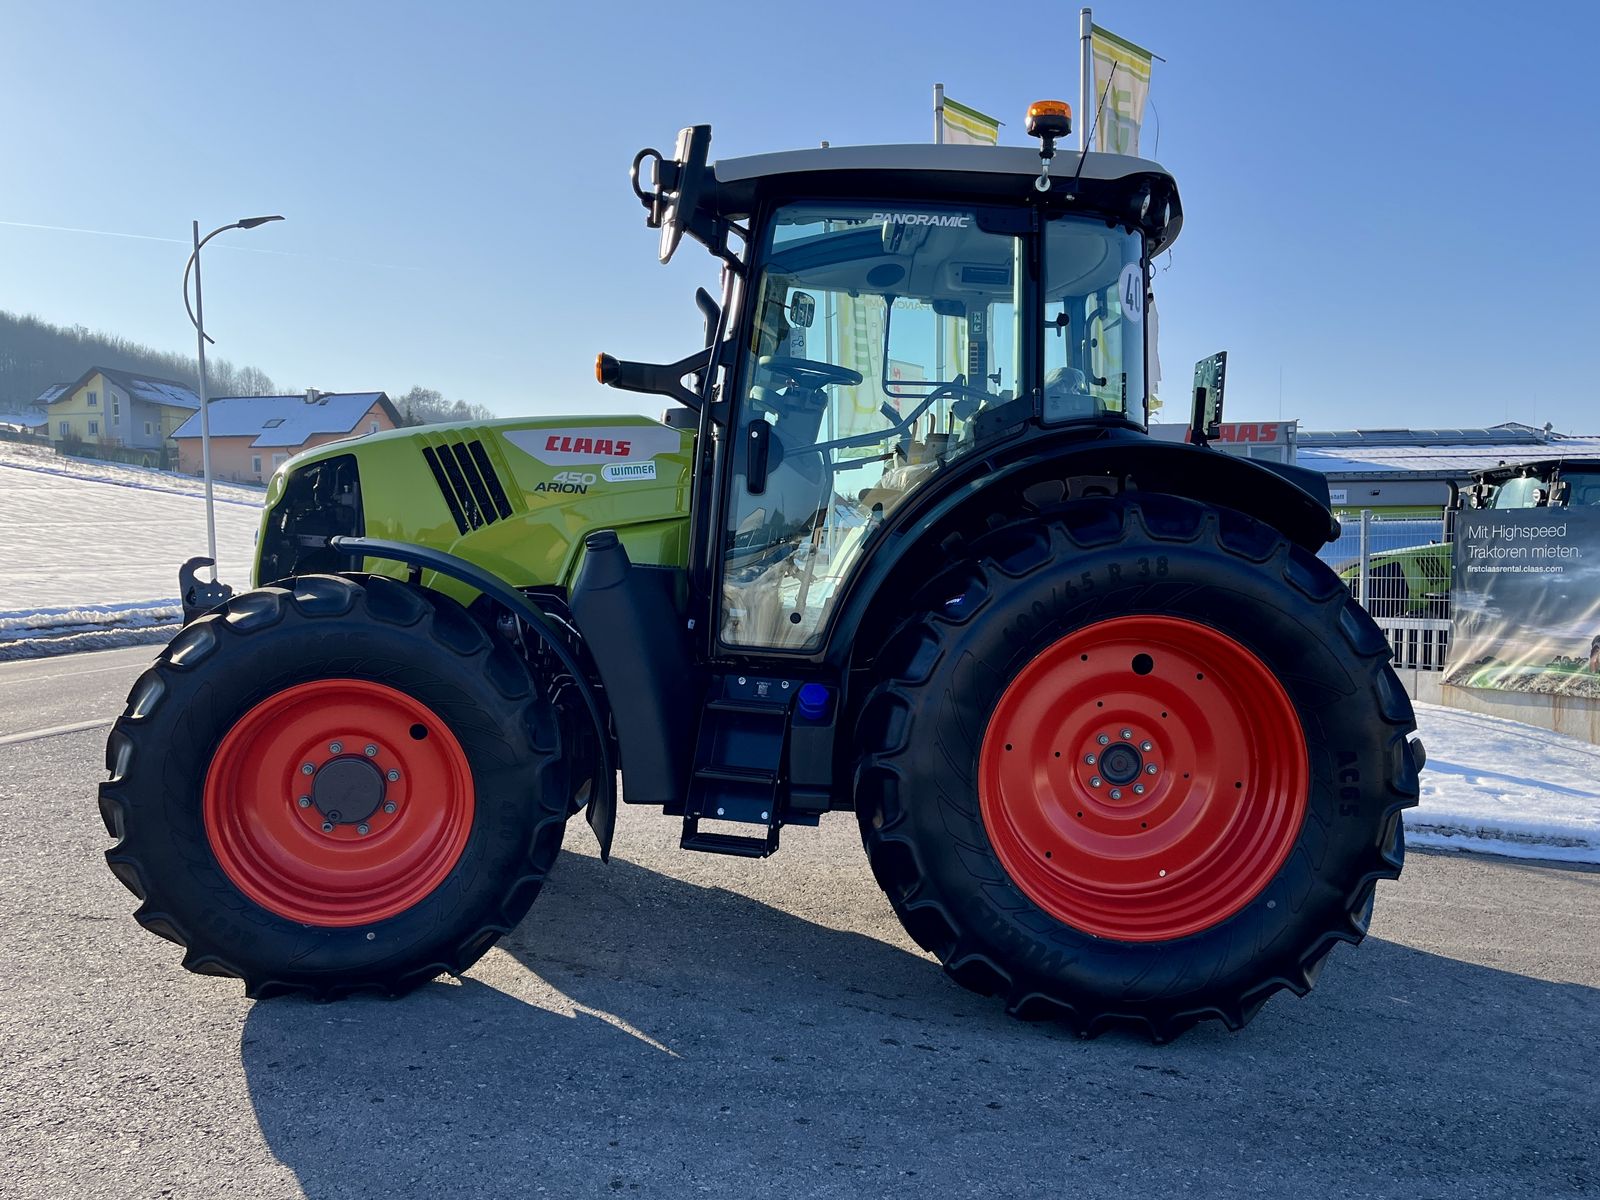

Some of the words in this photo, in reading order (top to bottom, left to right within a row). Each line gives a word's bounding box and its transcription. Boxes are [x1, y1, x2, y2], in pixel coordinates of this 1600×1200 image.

[872, 212, 970, 228] PANORAMIC
[1126, 272, 1141, 313] 40
[1184, 423, 1280, 444] AAS
[545, 436, 631, 456] CLAAS
[552, 471, 597, 485] 450
[611, 464, 655, 476] WIMMER
[534, 482, 588, 495] ARION
[1468, 525, 1489, 539] Mit
[1491, 523, 1567, 541] Highspeed
[1467, 545, 1527, 559] Traktoren
[1531, 544, 1583, 559] mieten.
[1136, 555, 1170, 577] 38
[1467, 565, 1564, 573] firstclaasrental.claas.com
